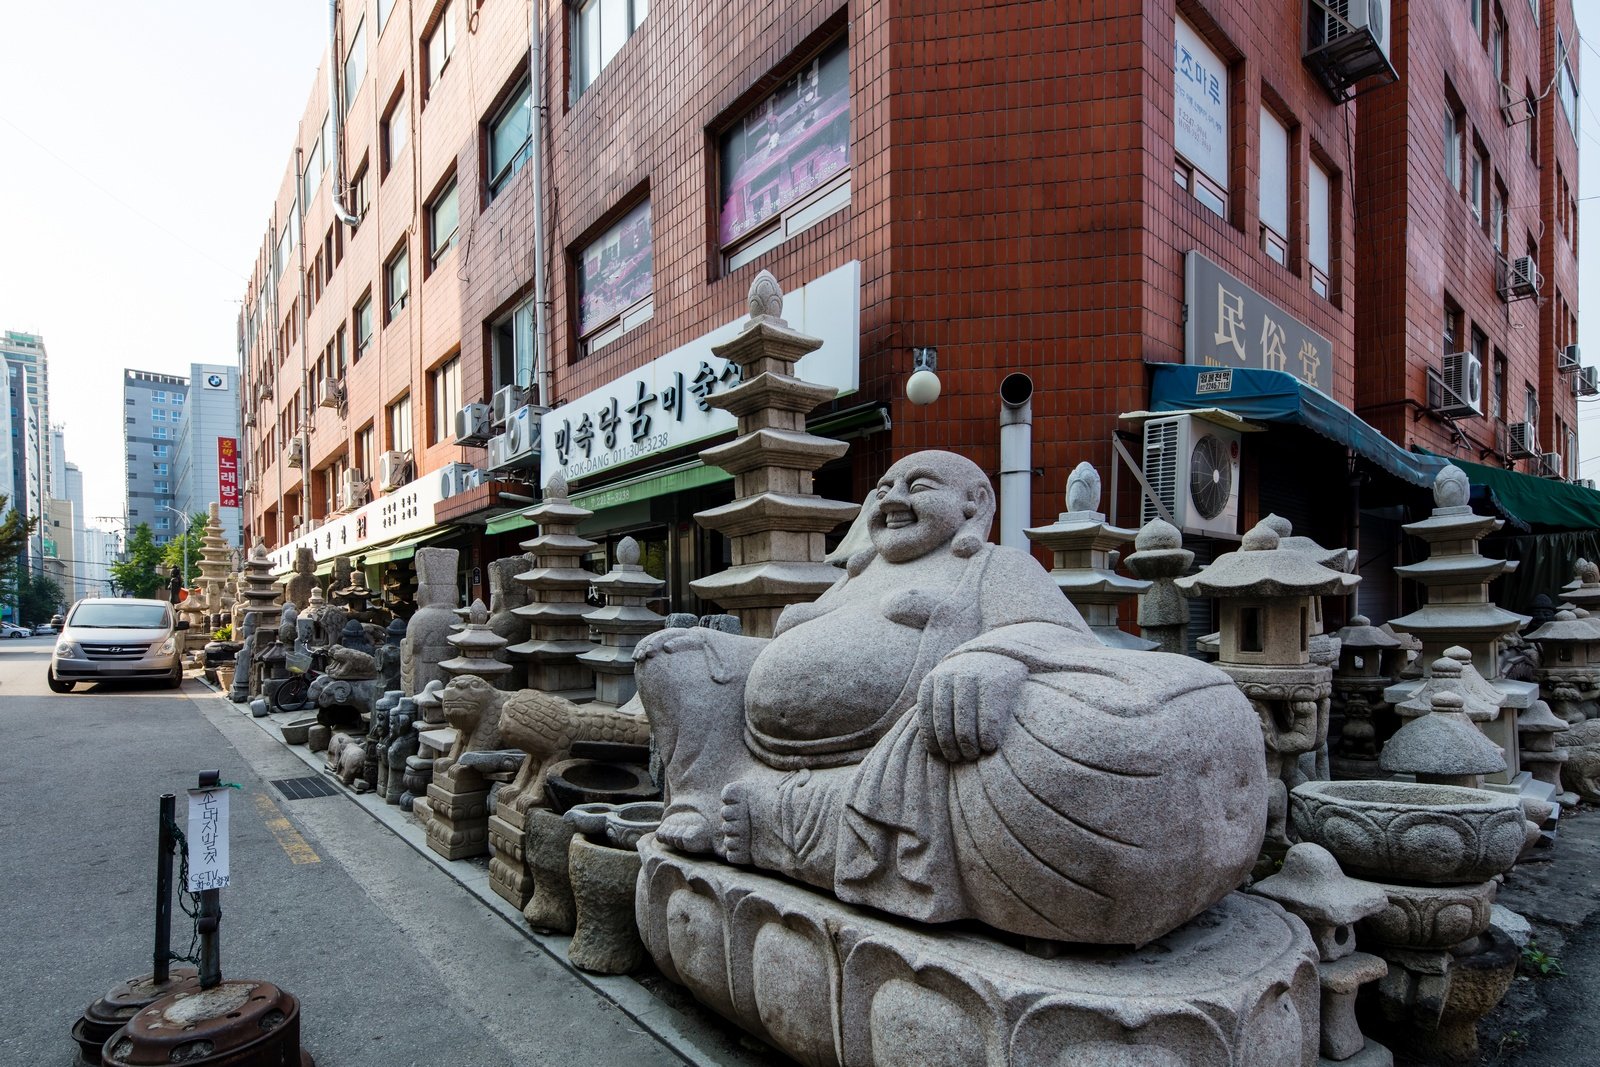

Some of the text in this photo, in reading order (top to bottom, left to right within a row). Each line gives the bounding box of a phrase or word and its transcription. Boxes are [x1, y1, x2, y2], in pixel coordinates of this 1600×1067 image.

[1214, 282, 1321, 388] 民俗堂
[570, 453, 609, 478] SOK-DANG
[613, 432, 668, 463] 011-304-3238
[220, 458, 236, 497] 노래방
[191, 869, 219, 882] CCTV
